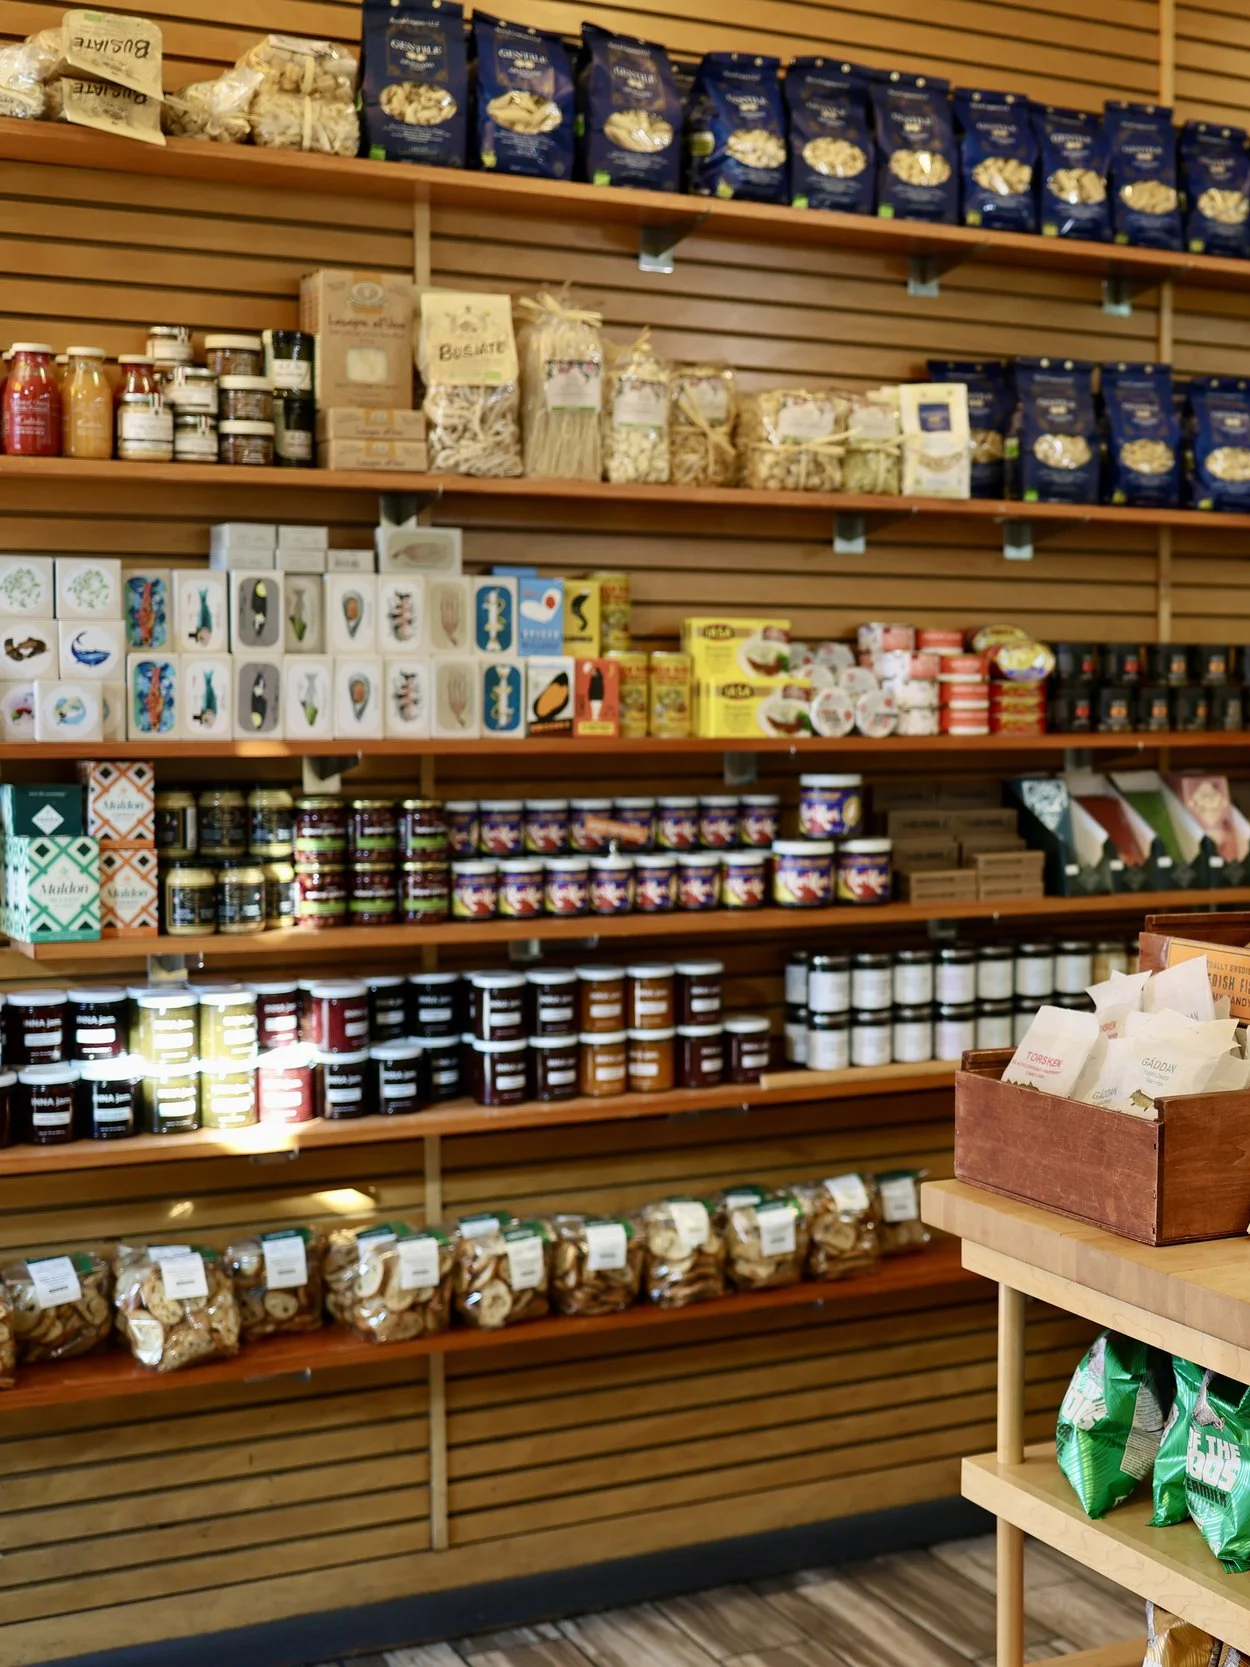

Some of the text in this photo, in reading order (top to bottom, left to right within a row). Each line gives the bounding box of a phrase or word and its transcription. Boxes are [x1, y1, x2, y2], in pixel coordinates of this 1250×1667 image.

[72, 36, 150, 59] BUSIATE
[390, 39, 442, 58] GENTILE
[439, 342, 506, 362] BUSIATE
[103, 801, 144, 809] Maldon
[41, 882, 89, 894] Maldon
[107, 890, 148, 898] Maldon
[1027, 1051, 1064, 1068] TORSKEN
[1206, 1434, 1241, 1460] THE
